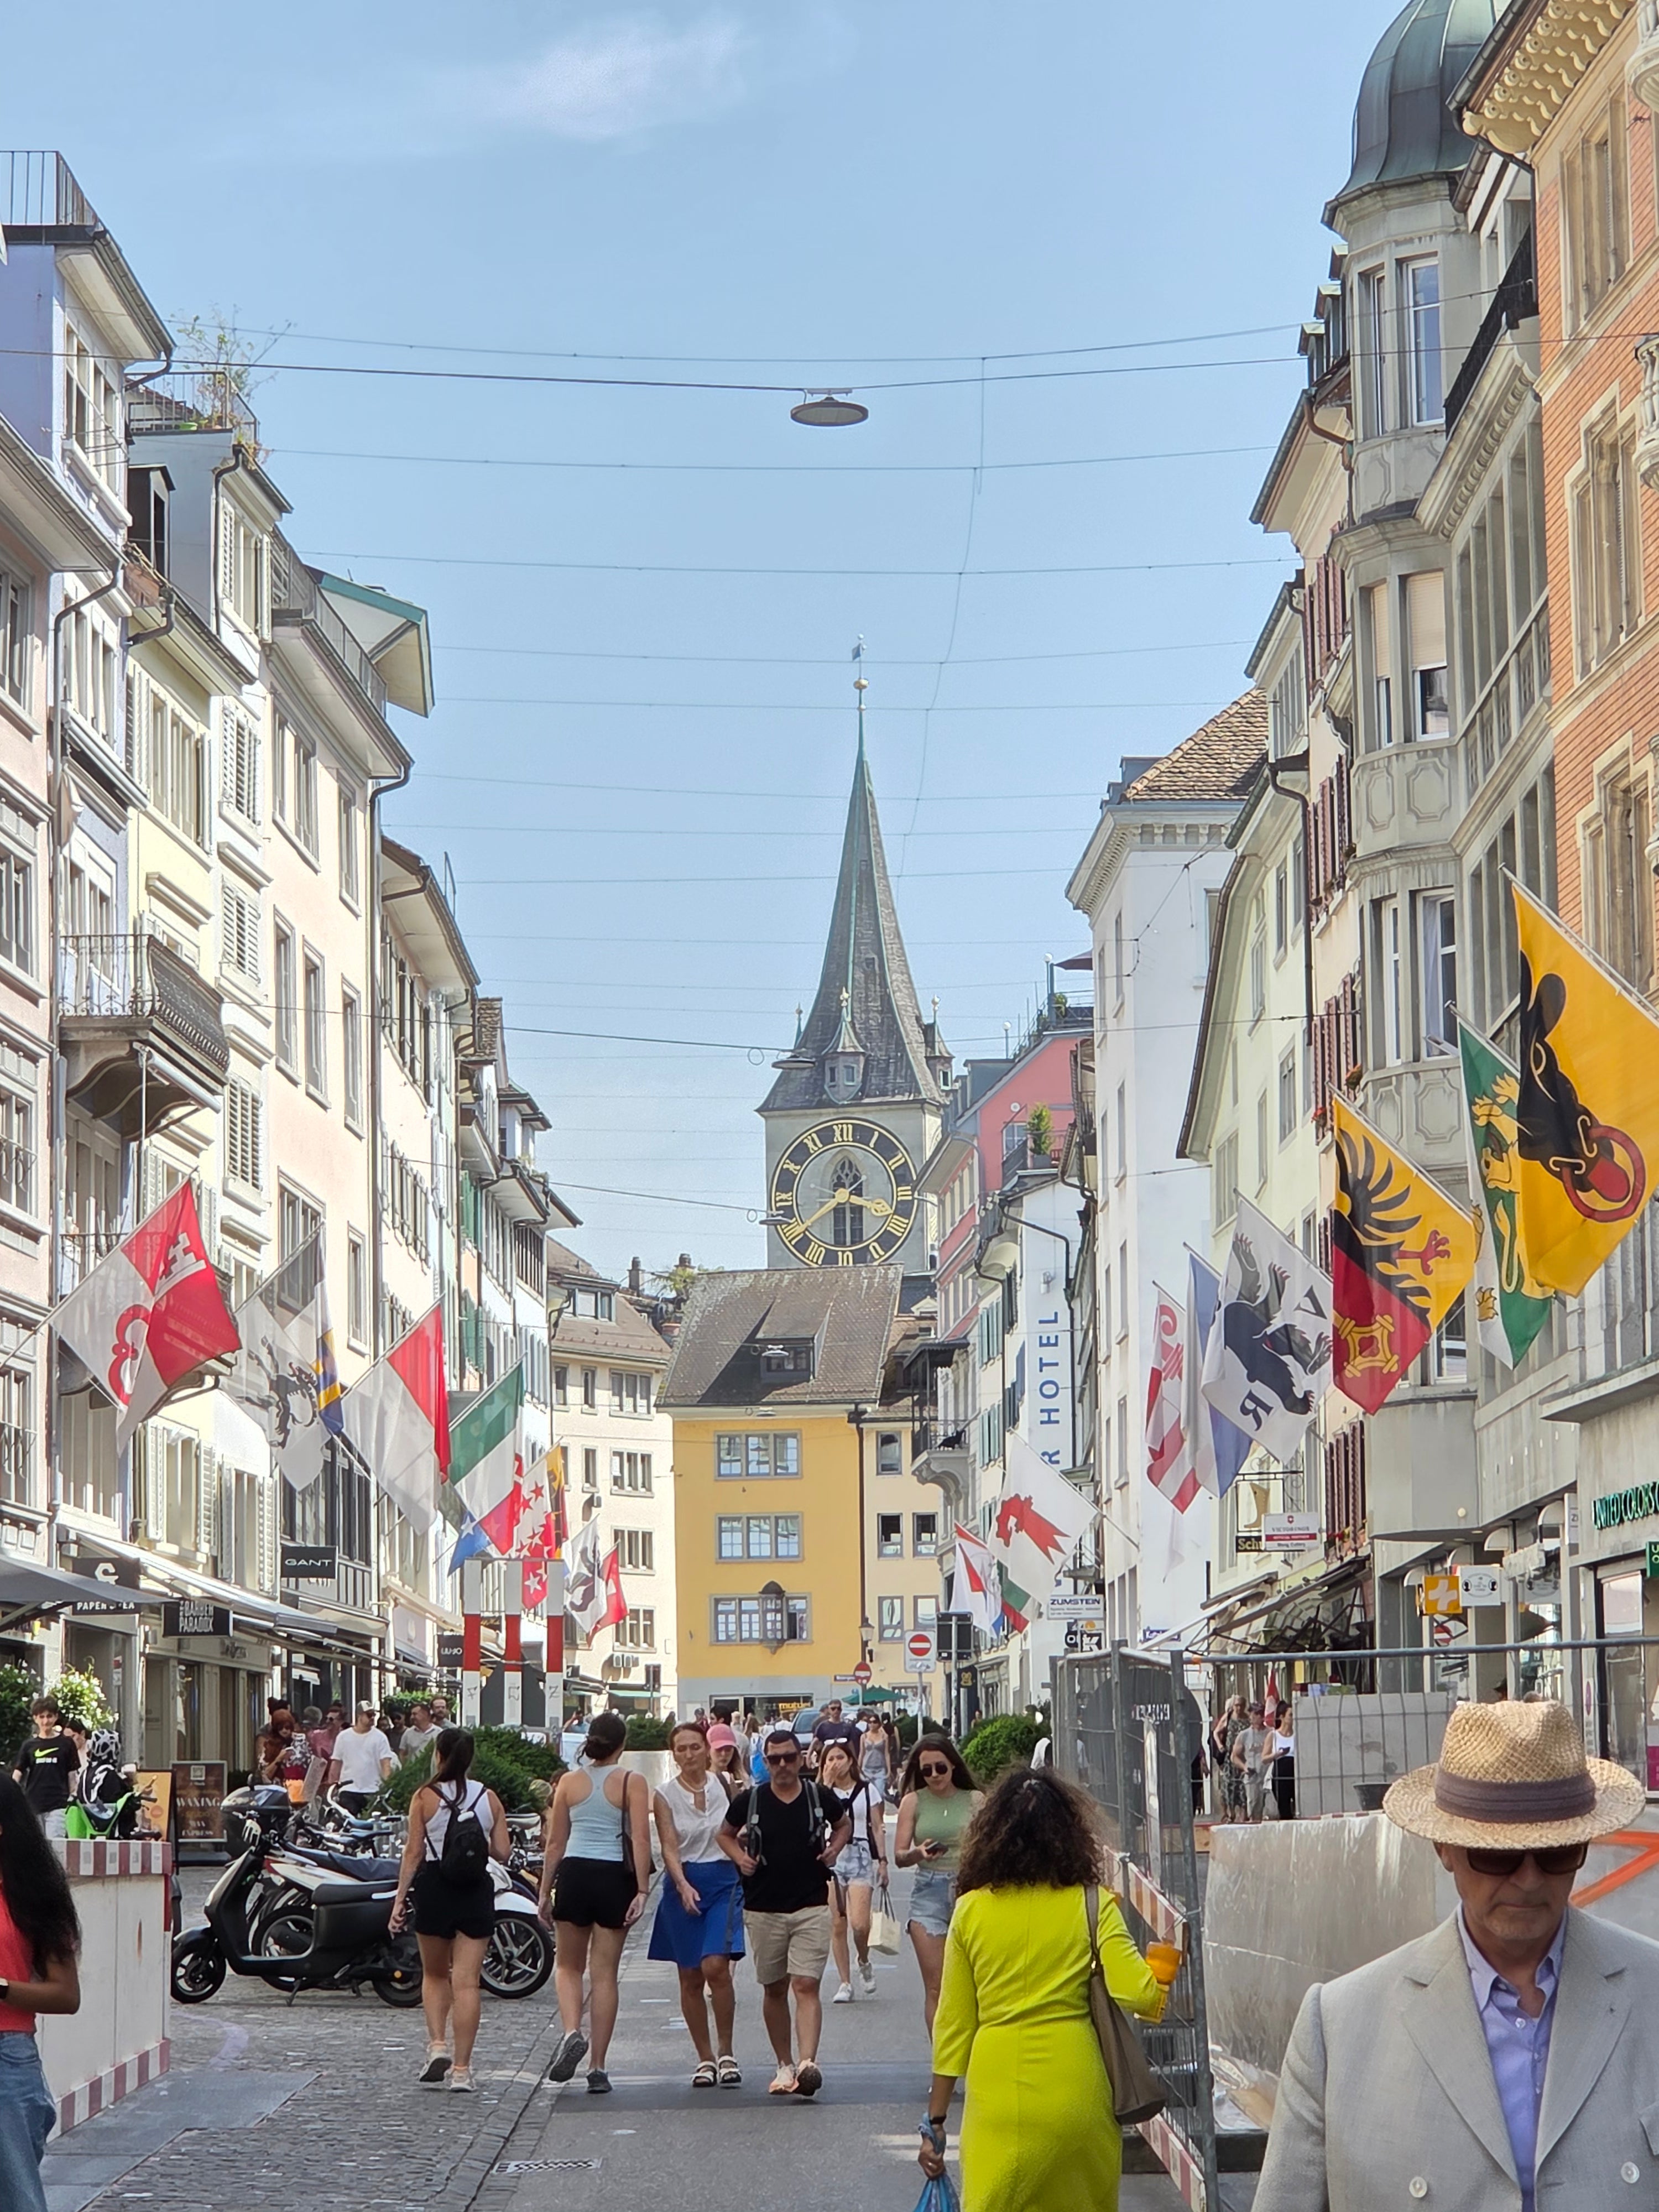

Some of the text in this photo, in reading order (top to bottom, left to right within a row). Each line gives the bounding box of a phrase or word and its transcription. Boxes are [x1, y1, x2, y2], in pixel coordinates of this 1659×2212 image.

[833, 1124, 853, 1142] XII
[869, 1131, 879, 1147] I
[803, 1133, 823, 1154] XI
[783, 1160, 801, 1175] X
[889, 1153, 905, 1170] II
[775, 1191, 793, 1207] IX
[898, 1186, 912, 1200] III
[805, 1241, 826, 1264] VII
[869, 1242, 885, 1259] V
[1038, 1311, 1060, 1425] HOTEL
[1592, 1493, 1620, 1529] UNITED
[1621, 1482, 1655, 1522] COLORS
[285, 1558, 332, 1567] GANT
[179, 1616, 213, 1632] PARADOX
[176, 1797, 220, 1807] WAXING
